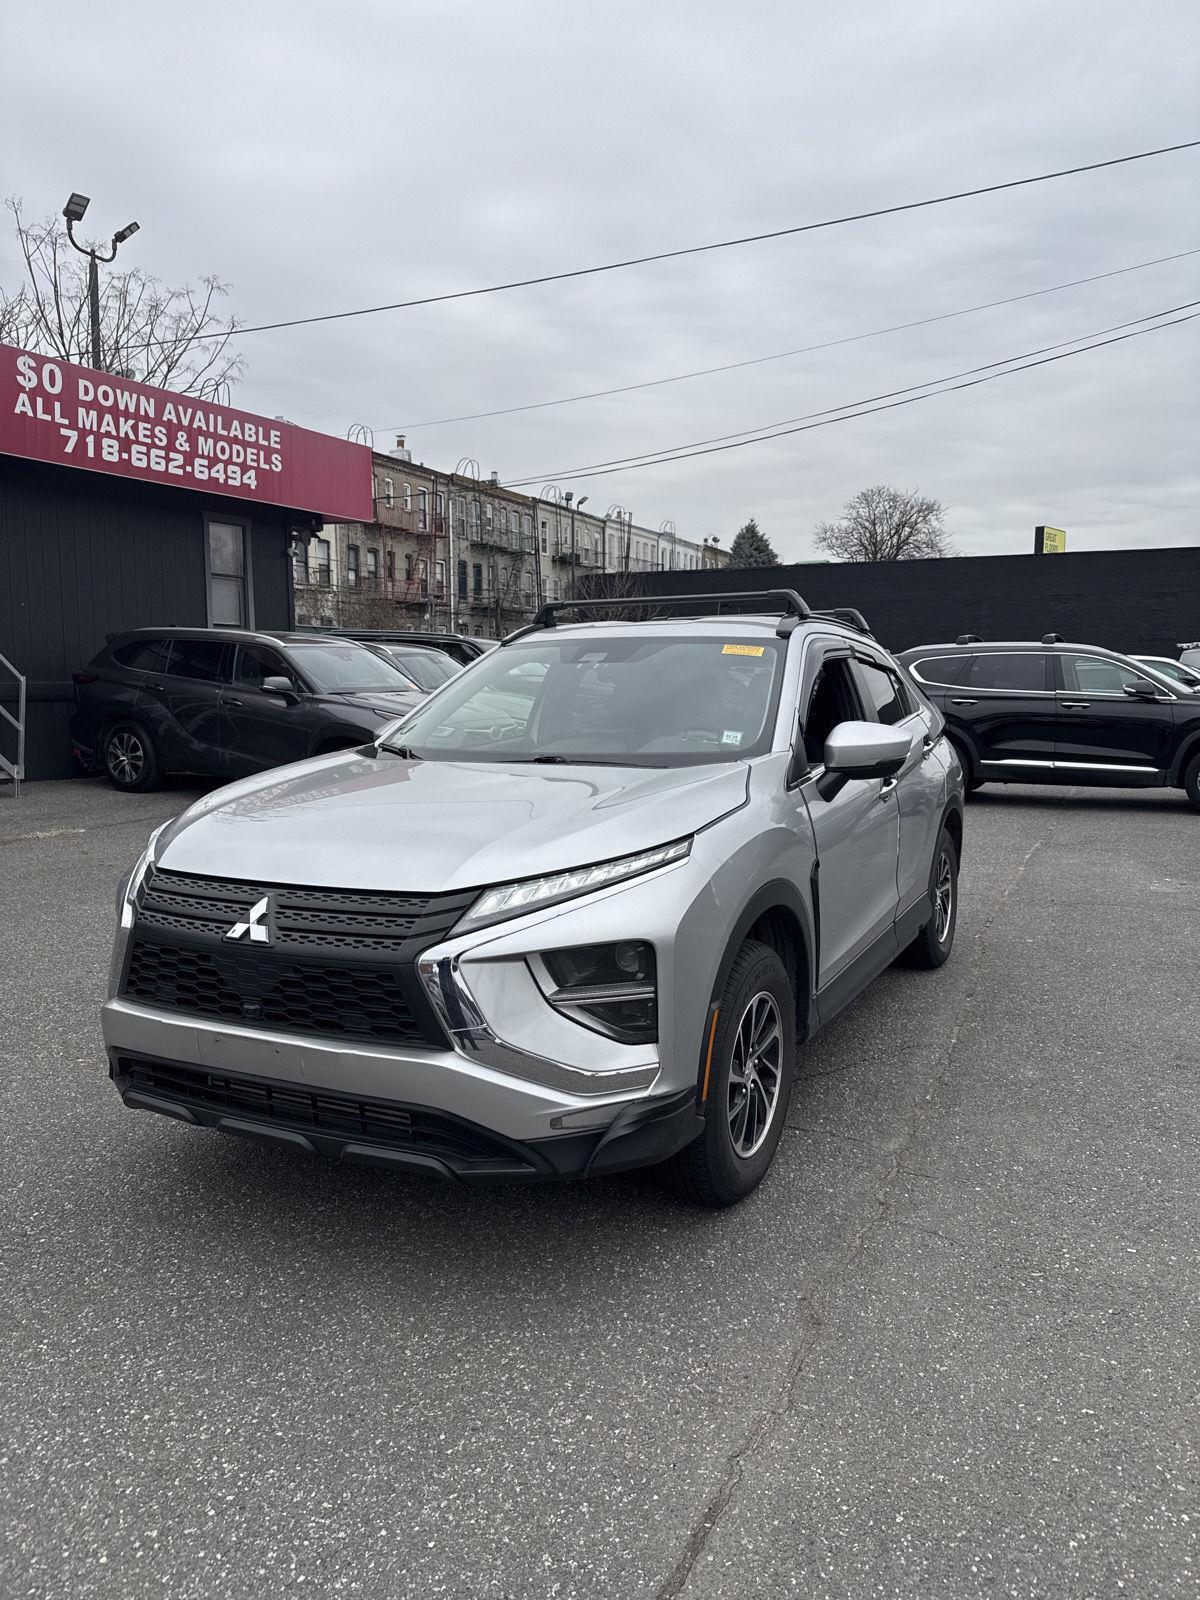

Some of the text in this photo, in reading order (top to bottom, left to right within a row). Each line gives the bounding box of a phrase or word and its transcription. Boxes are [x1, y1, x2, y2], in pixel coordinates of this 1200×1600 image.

[14, 392, 282, 473] ALL MAKES & MODELS
[16, 355, 281, 450] $0 DOWN AVAILABLE
[60, 427, 257, 490] 718-662-6494
